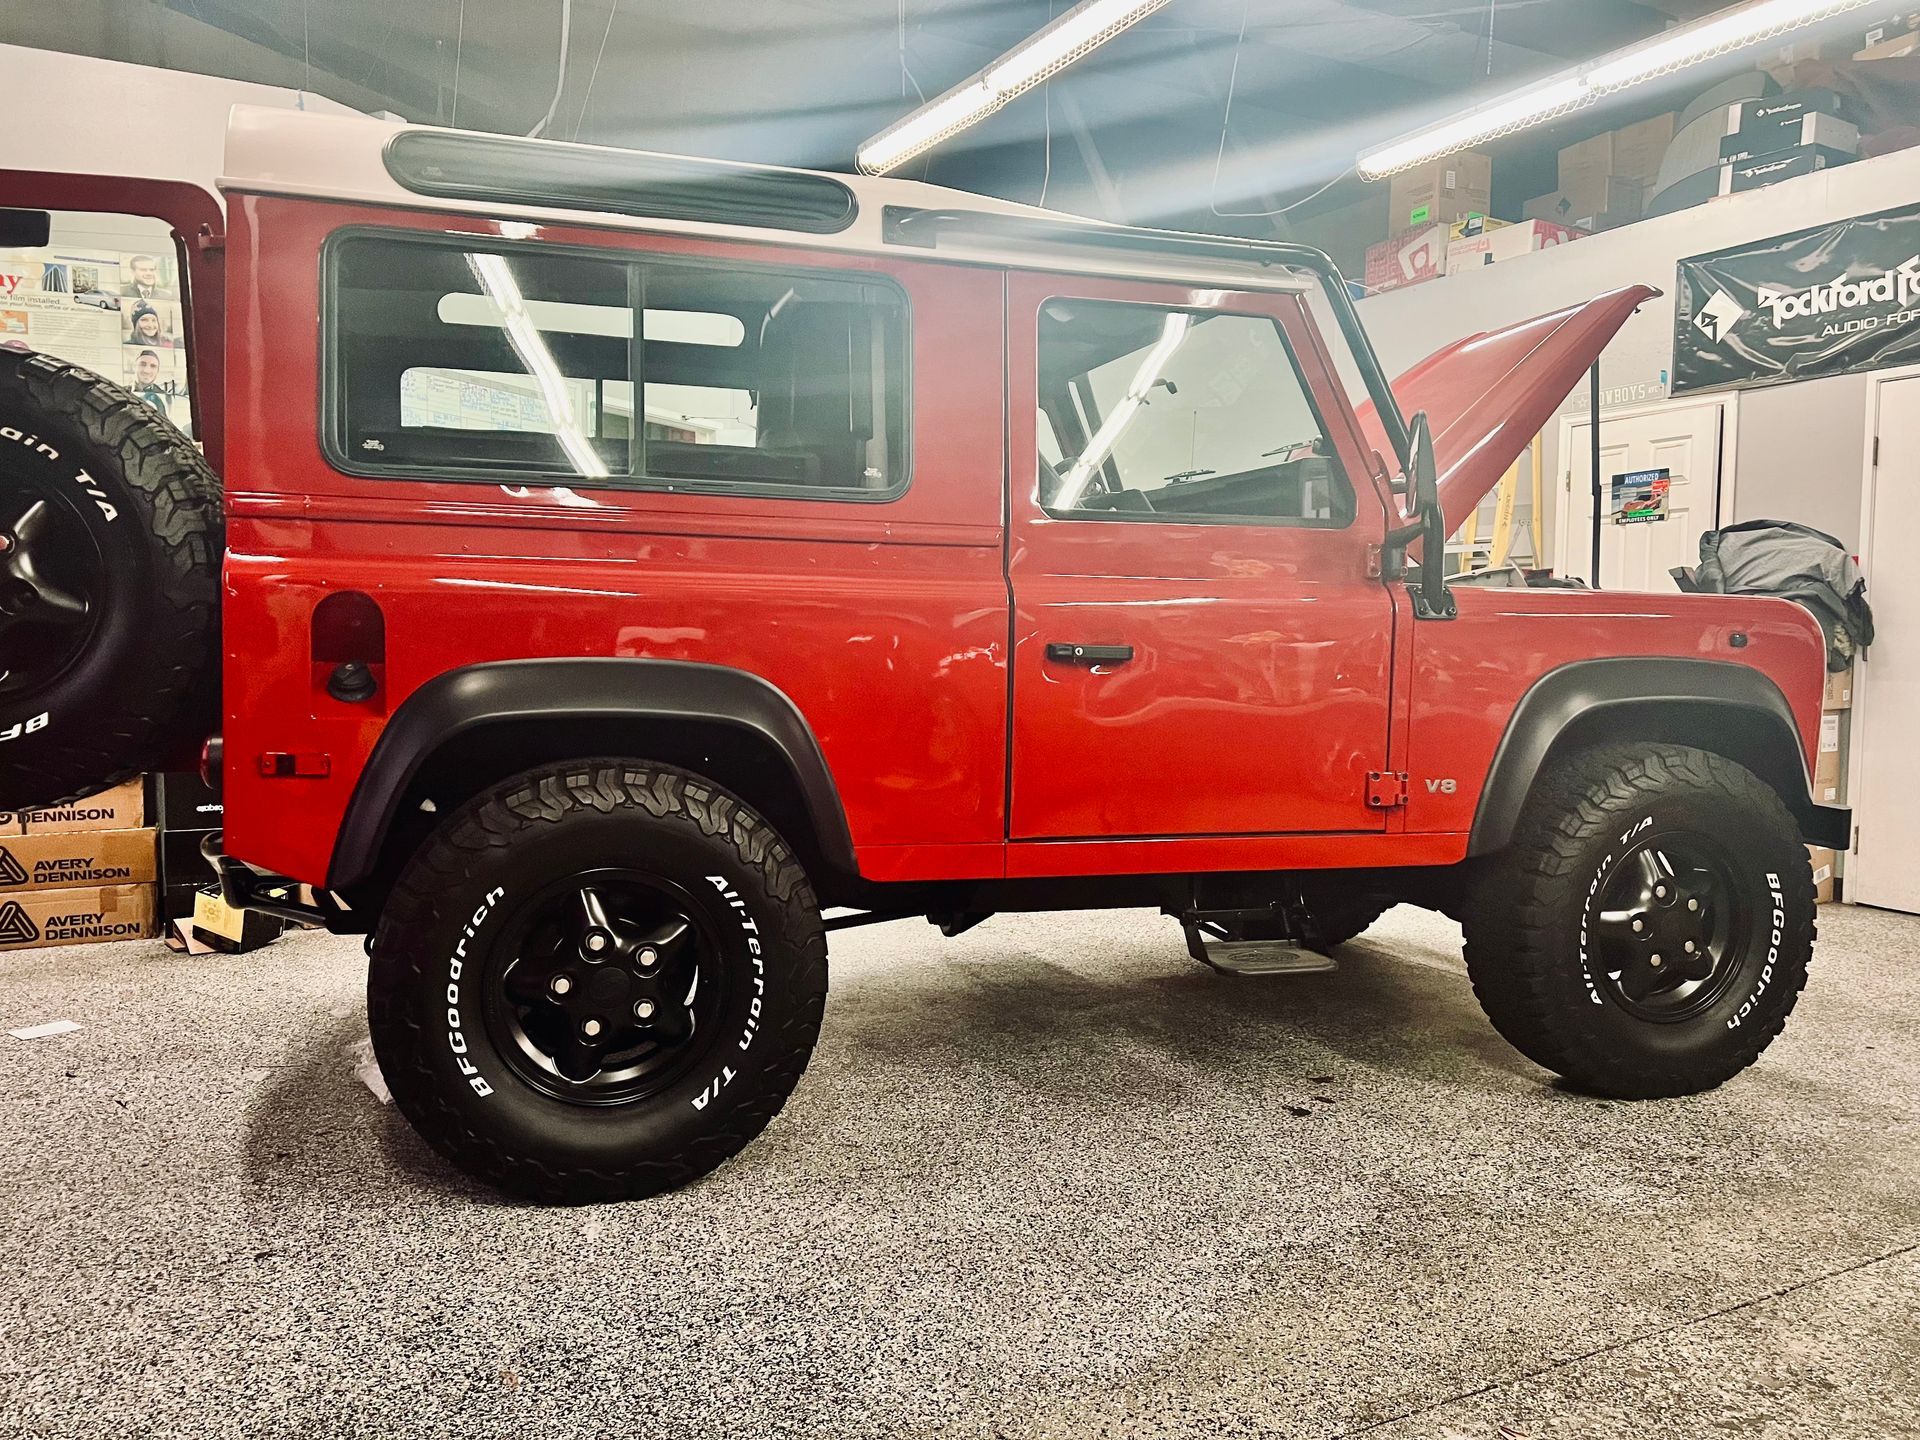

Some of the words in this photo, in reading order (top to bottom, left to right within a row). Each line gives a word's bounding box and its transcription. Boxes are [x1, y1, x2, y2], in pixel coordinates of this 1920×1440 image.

[28, 296, 60, 305] installed
[1757, 269, 1895, 330] Rockford
[1821, 316, 1878, 337] AUDIO
[1599, 383, 1646, 406] OWBOYS
[1624, 472, 1659, 485] AUTHORIZED
[75, 468, 118, 522] T/A
[1618, 516, 1646, 524] EMPLOYEES
[1425, 779, 1457, 794] V8
[17, 808, 115, 824] DENNISON
[1620, 816, 1653, 845] T/A
[33, 857, 95, 872] AVERY
[33, 867, 131, 884] DENNISON
[45, 912, 105, 928] AVERY
[1579, 854, 1612, 1005] All-Terrain
[45, 922, 141, 941] DENNISON
[1726, 872, 1786, 1031] BFGoodrich
[705, 874, 765, 1051] All-Terrain
[446, 886, 505, 1098] BFGoodrich
[691, 1066, 737, 1111] T/A
